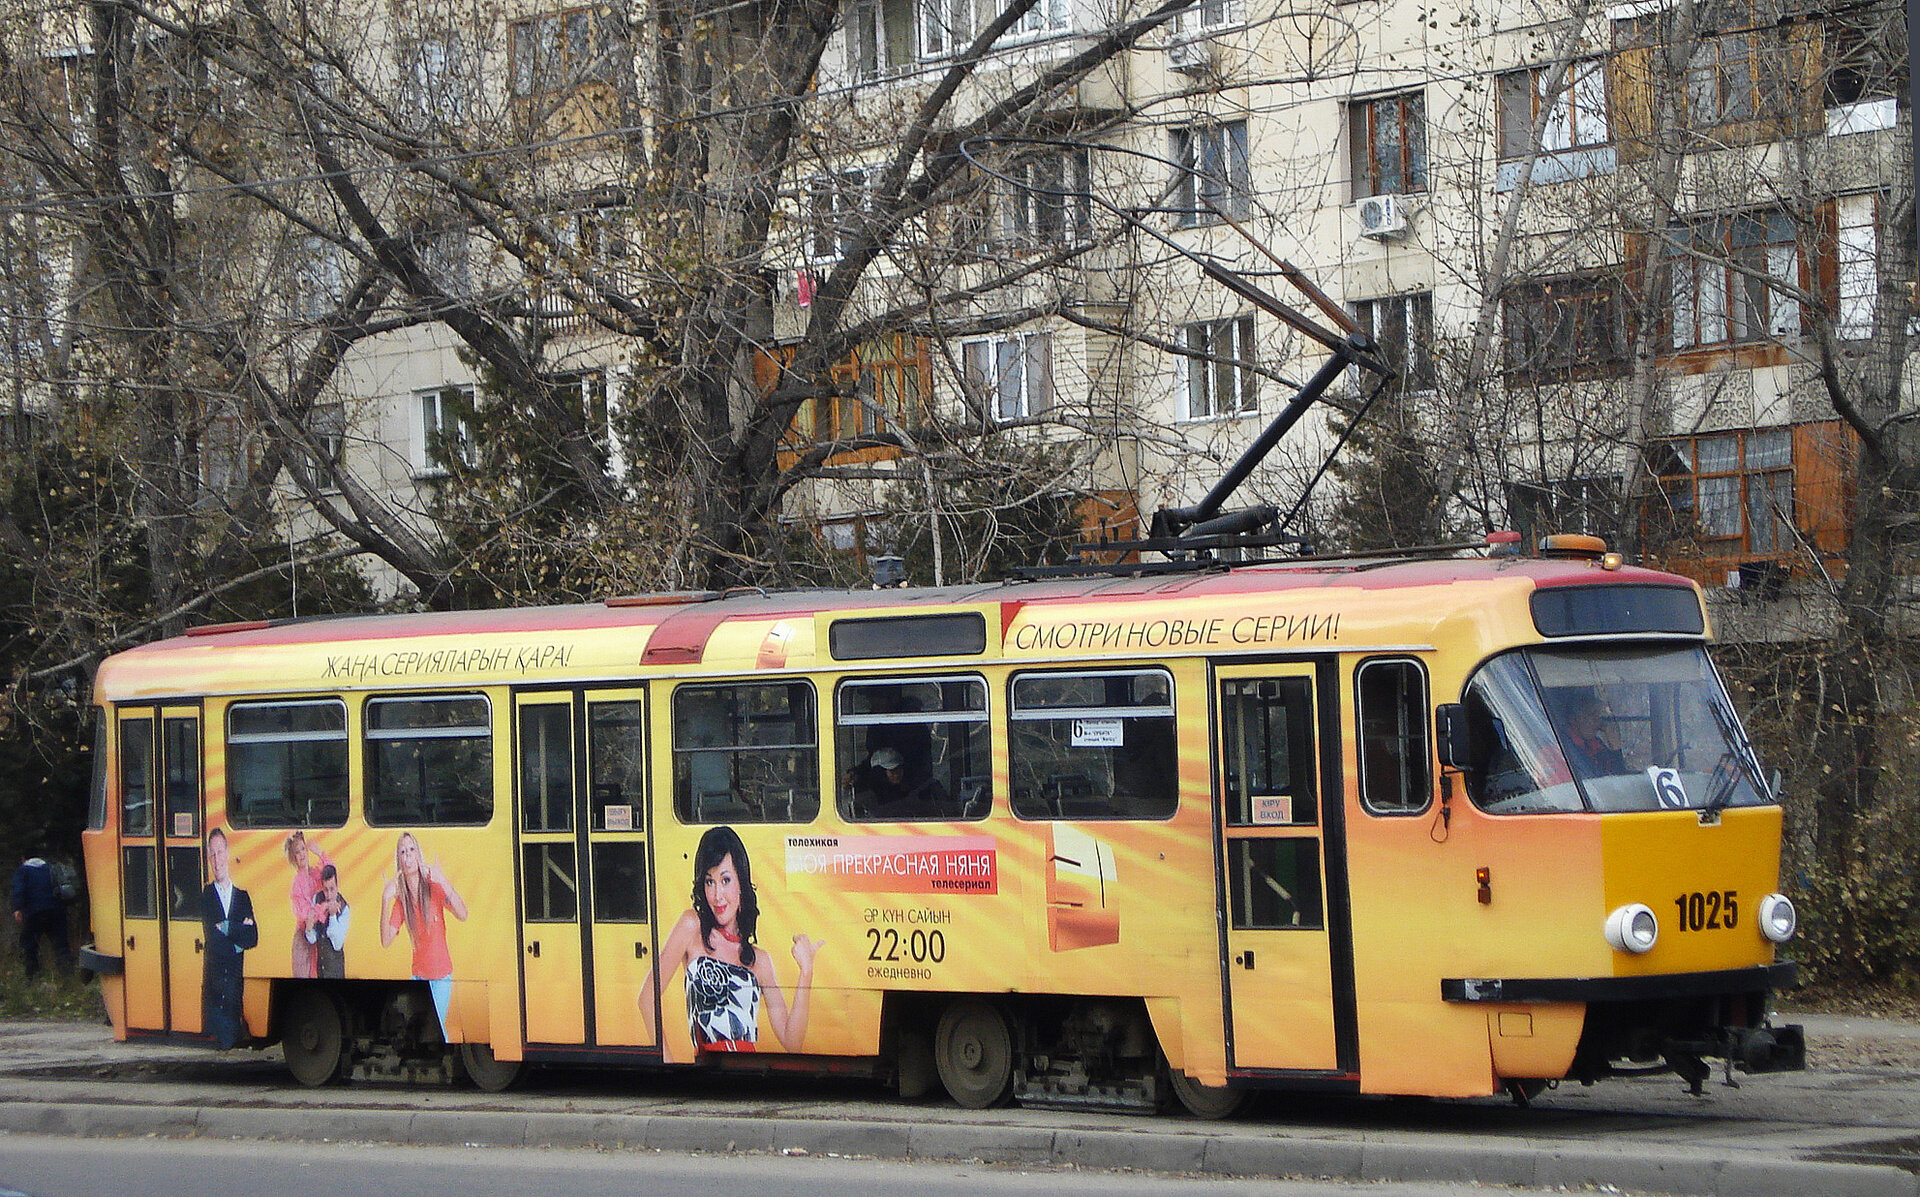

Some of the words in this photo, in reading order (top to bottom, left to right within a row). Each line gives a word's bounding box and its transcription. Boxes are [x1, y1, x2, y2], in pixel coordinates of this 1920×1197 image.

[1016, 622, 1123, 650] СМОТРИ
[1126, 618, 1225, 647] НОВЫЕ
[1232, 613, 1341, 643] СЕРИИ!
[321, 654, 377, 682] ЖАҢА
[381, 647, 512, 675] СЕРИЯЛАРЫН
[514, 644, 574, 675] ҚАРА!
[1073, 719, 1083, 738] 6
[1656, 771, 1687, 808] 6
[788, 838, 839, 847] телехикая
[833, 854, 940, 876] ПРЕКРАСНАЯ
[945, 855, 991, 876] НЯНЯ
[931, 880, 991, 892] телесериал
[907, 907, 951, 924] САЙЫН
[1674, 890, 1738, 932] 1025
[866, 928, 945, 963] 22:00
[867, 966, 932, 980] ежедневно
